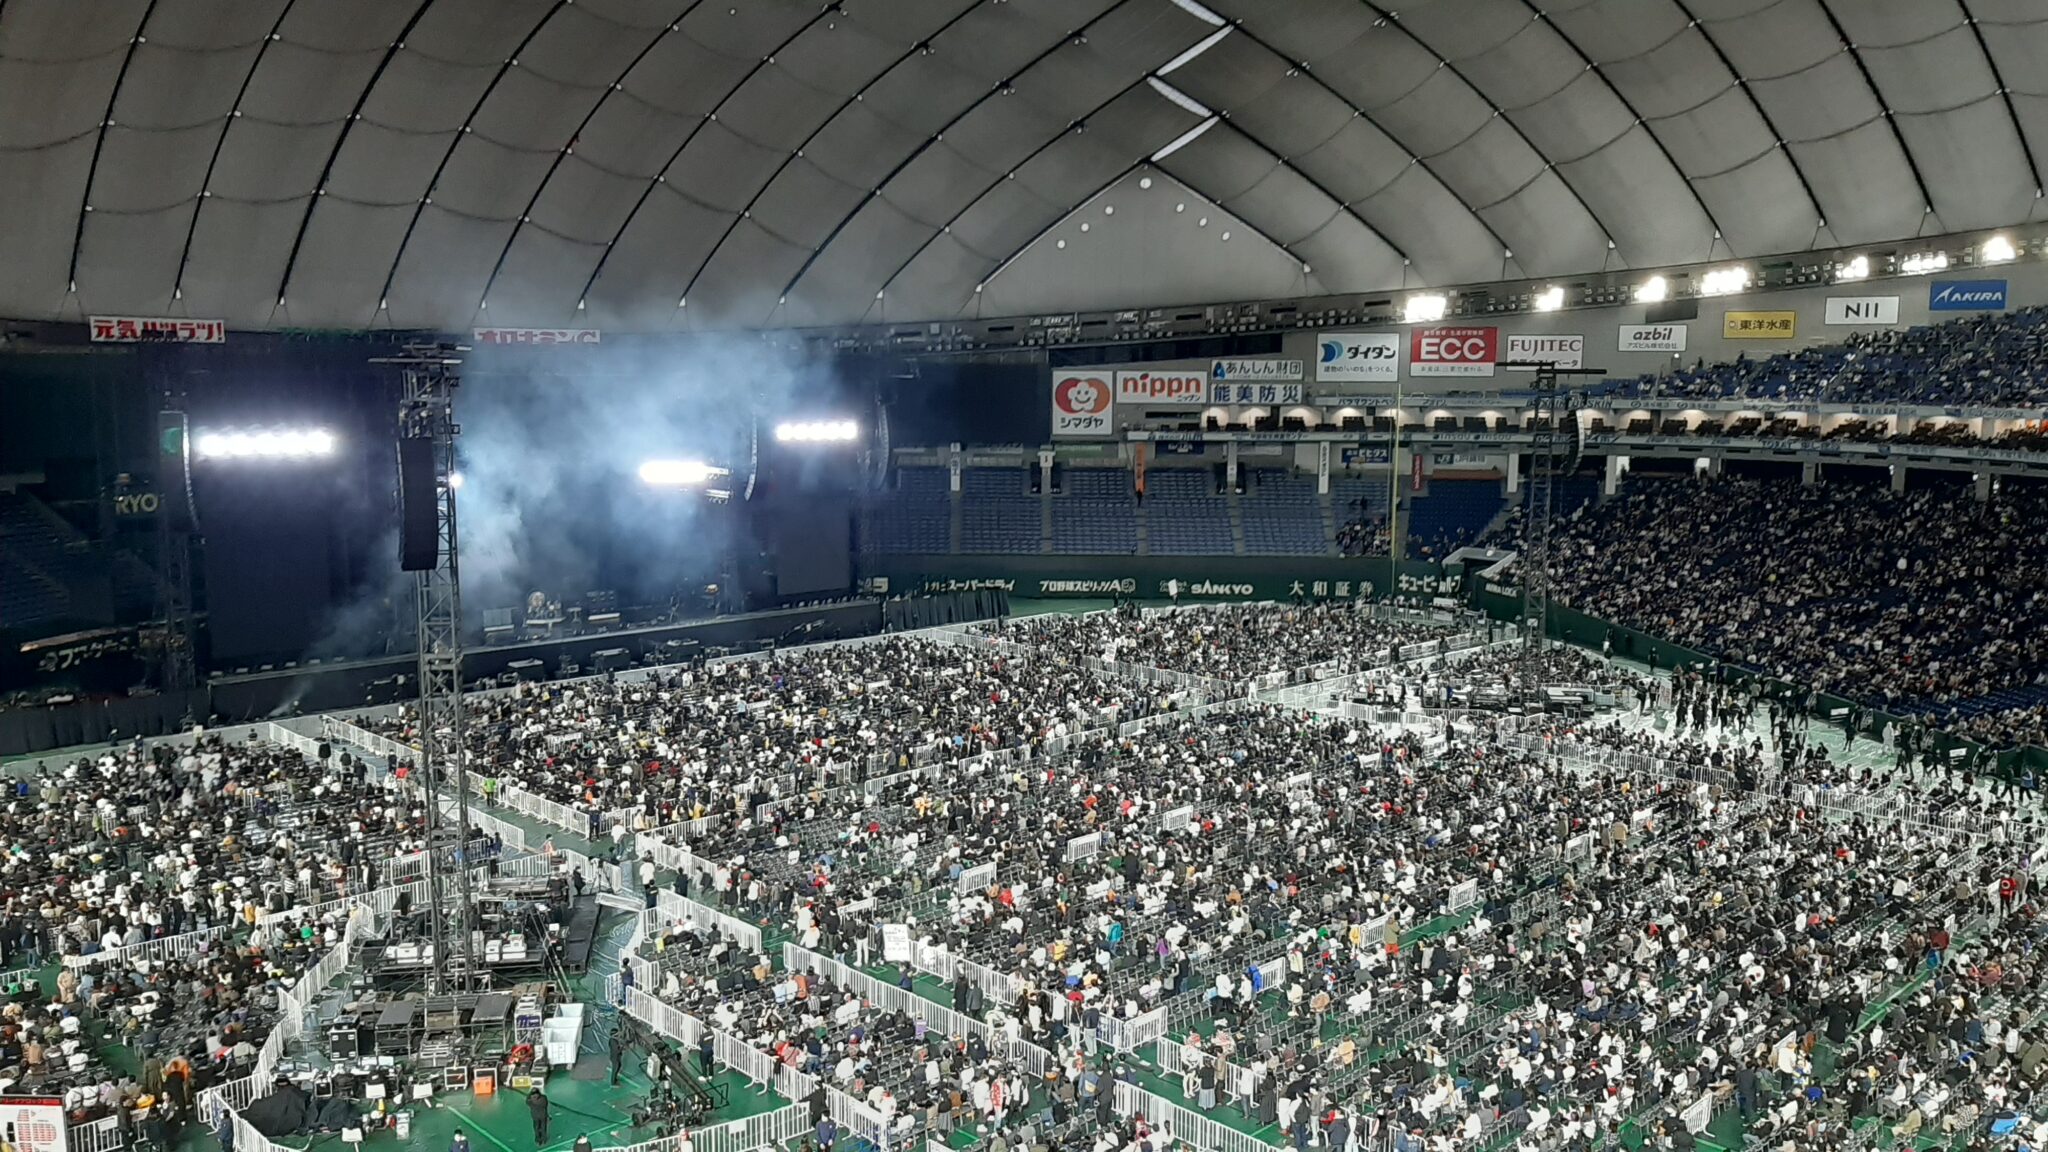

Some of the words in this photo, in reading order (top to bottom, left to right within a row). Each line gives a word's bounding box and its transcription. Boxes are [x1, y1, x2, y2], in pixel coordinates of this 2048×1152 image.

[1950, 291, 2002, 302] AKIRA
[1739, 319, 1791, 330] 東洋水産
[1633, 328, 1672, 341] azbil
[1346, 344, 1396, 359] ダイダン
[1420, 337, 1486, 360] ECC
[1510, 339, 1581, 356] FUJITEC
[1226, 361, 1301, 374] あんしん財団
[1122, 373, 1201, 397] nippn
[1214, 385, 1299, 402] 能美防災
[1060, 416, 1104, 429] シマダヤ
[1191, 579, 1254, 595] SANKYO
